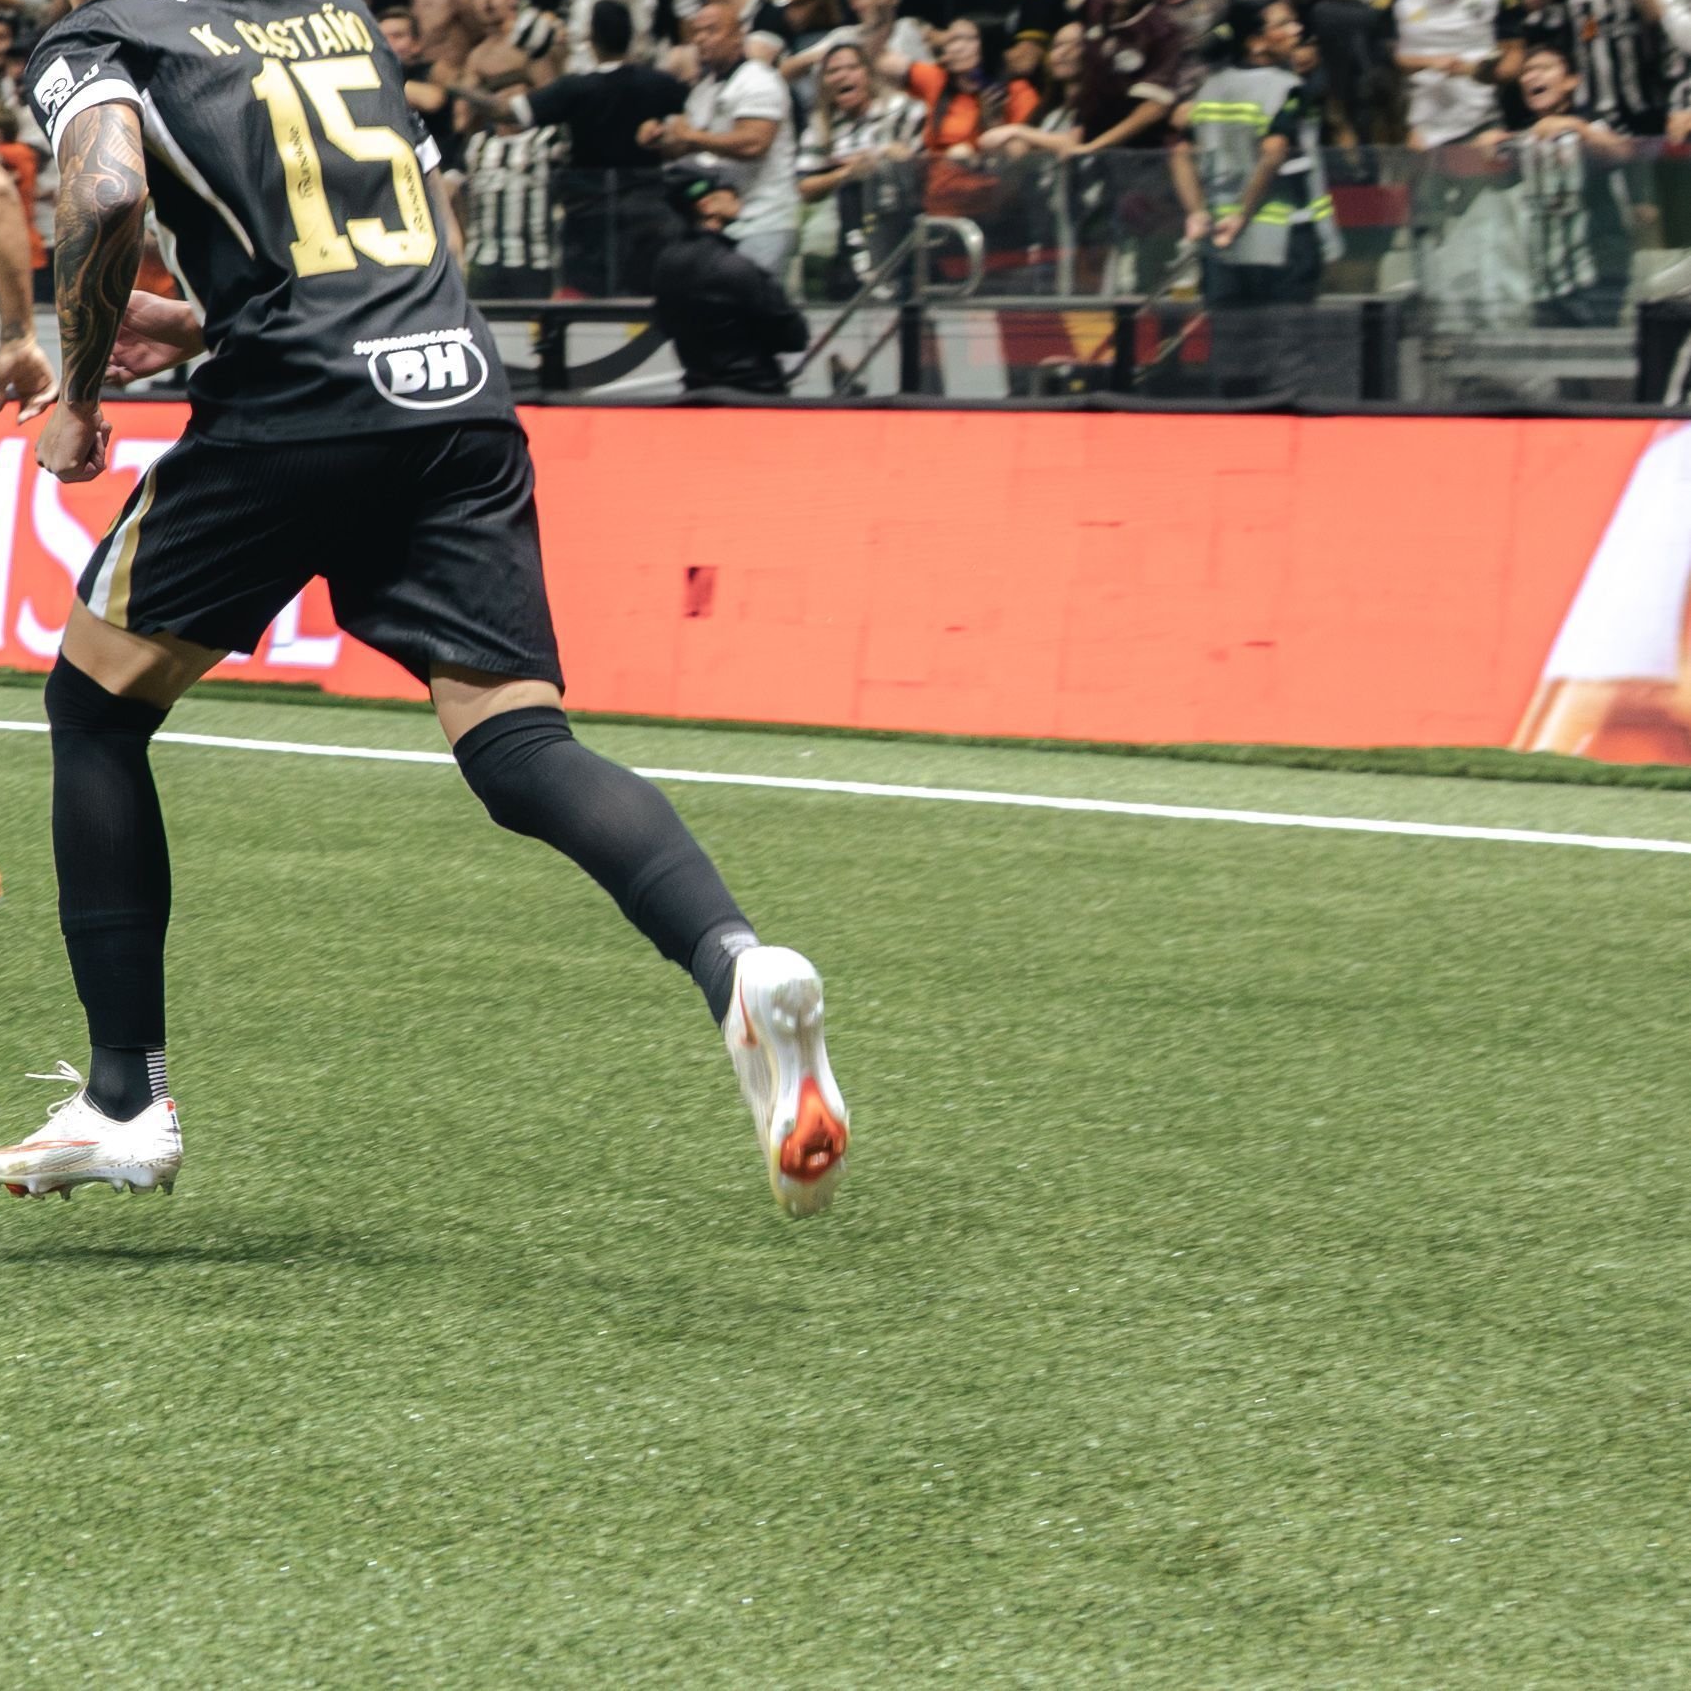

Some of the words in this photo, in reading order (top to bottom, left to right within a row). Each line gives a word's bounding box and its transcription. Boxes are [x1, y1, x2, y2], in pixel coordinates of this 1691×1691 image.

[189, 23, 241, 56] K.
[252, 55, 437, 278] 15
[386, 343, 470, 394] BH
